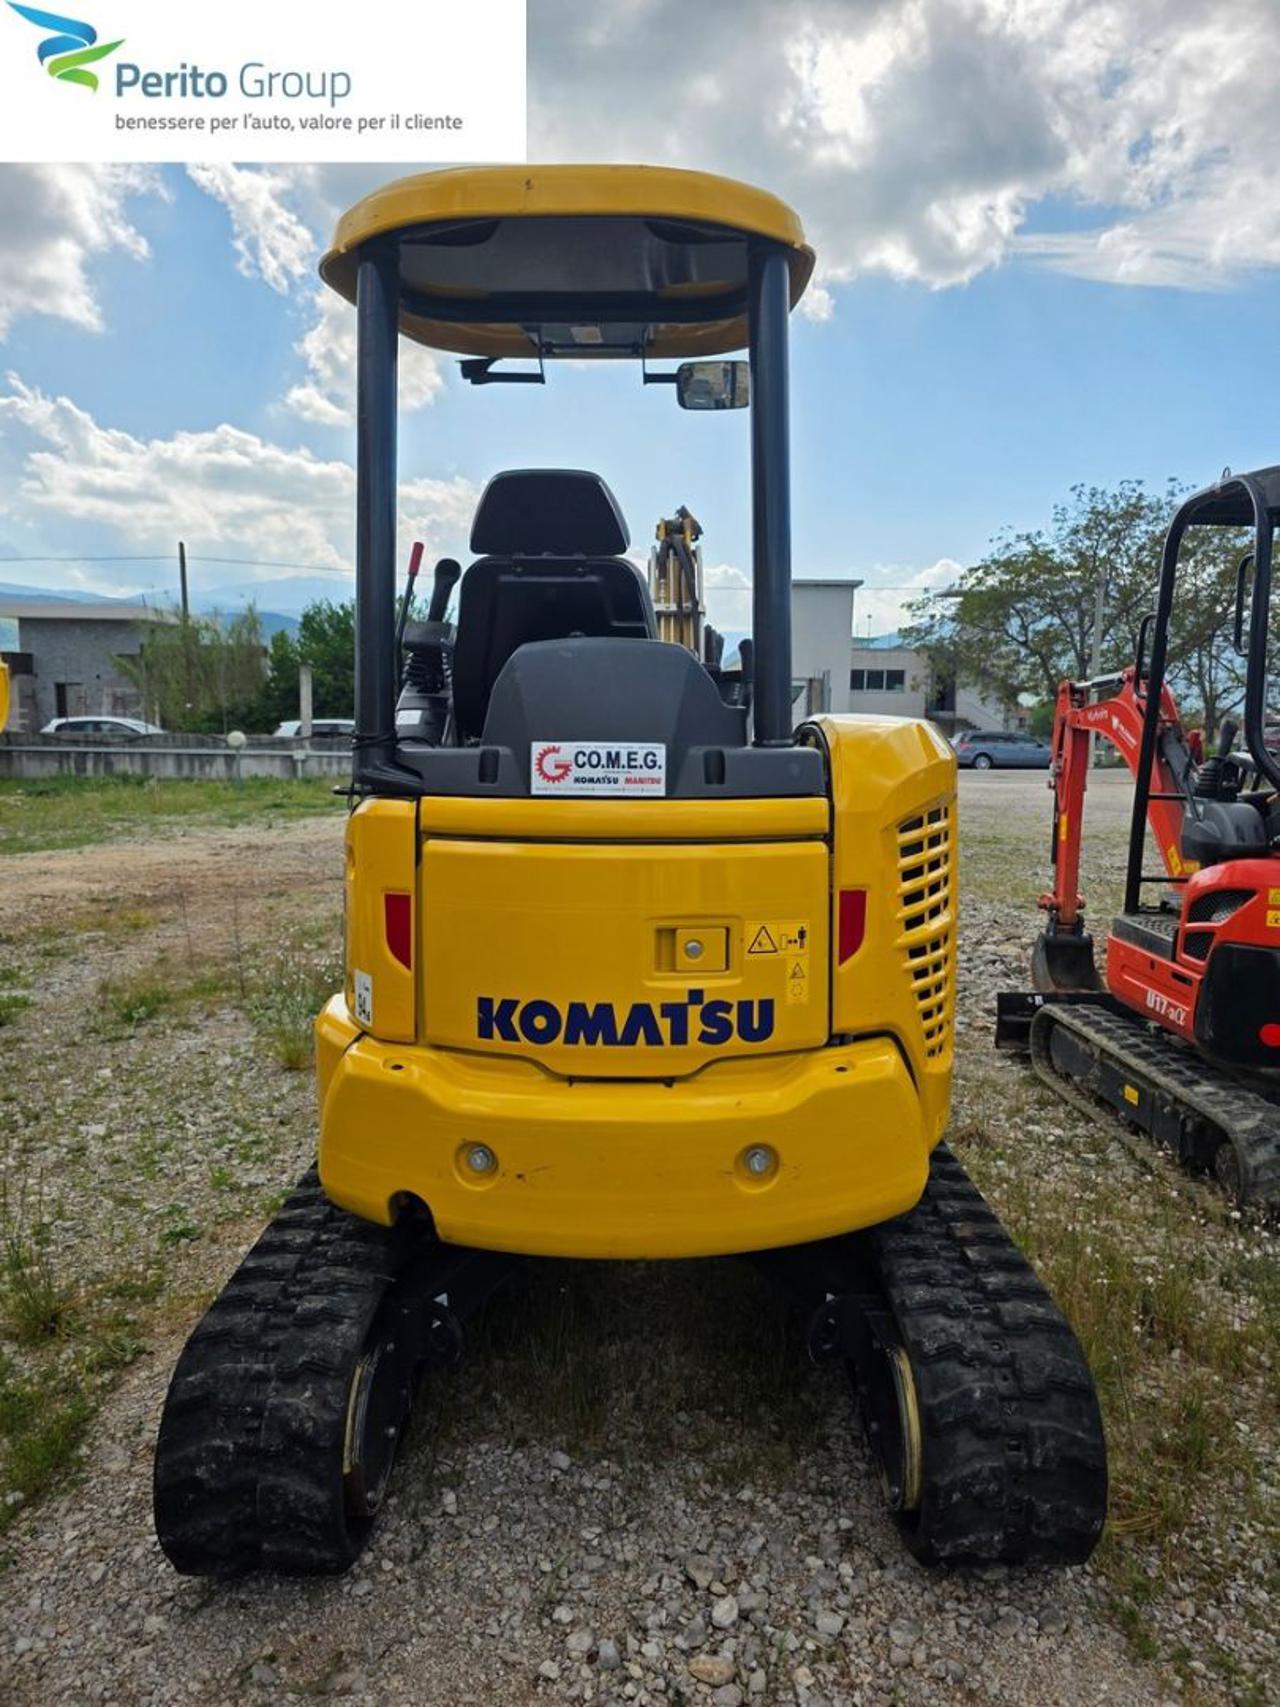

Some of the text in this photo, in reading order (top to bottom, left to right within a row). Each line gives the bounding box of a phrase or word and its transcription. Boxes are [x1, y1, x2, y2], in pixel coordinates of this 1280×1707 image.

[574, 750, 662, 770] CO.M.E.G.
[573, 775, 662, 785] KOMATSU MANITOU
[477, 989, 775, 1046] KOMATSU
